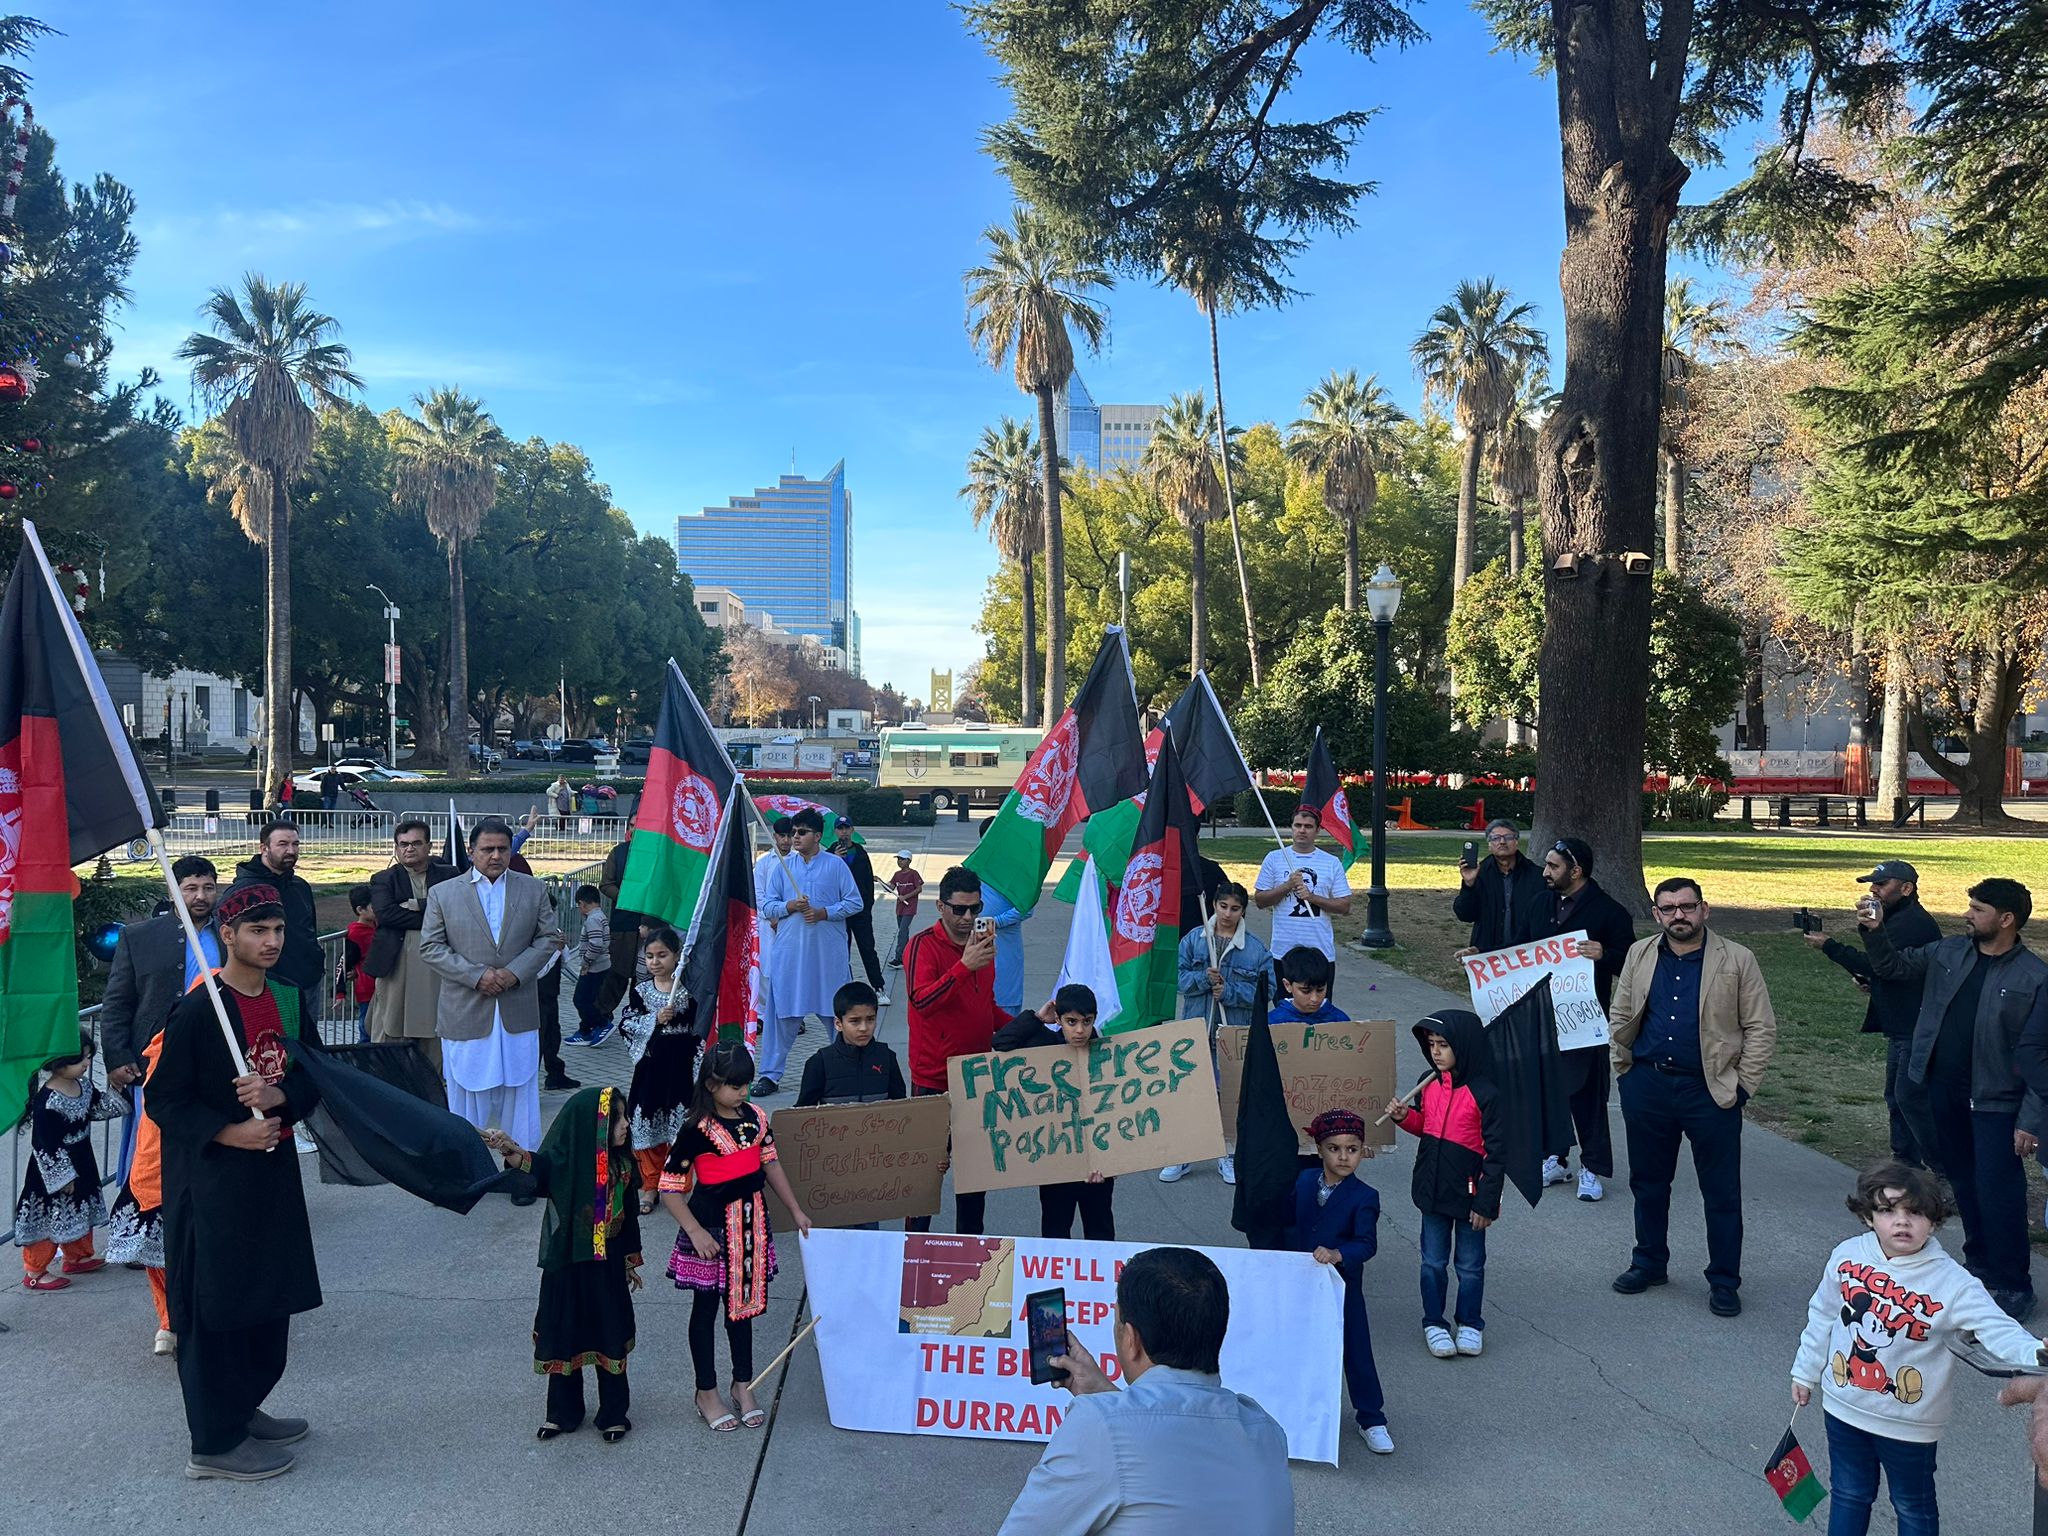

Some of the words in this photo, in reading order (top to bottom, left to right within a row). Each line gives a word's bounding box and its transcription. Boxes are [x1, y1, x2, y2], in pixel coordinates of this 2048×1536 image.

[767, 752, 788, 760] DPR
[805, 752, 825, 761] DPR
[1735, 758, 1753, 766] DPR
[1770, 758, 1790, 766] DPR
[1807, 758, 1827, 766] DPR
[1467, 937, 1582, 990] RELEASE
[1488, 972, 1588, 1015] MAOOR
[961, 1053, 1082, 1100] Free
[1088, 1036, 1198, 1084] Free
[800, 1142, 929, 1182] Pashteen
[807, 1176, 913, 1210] Genocide
[924, 1239, 964, 1247] AFGHANISTAN
[1021, 1255, 1105, 1282] WE'LL
[1838, 1260, 1944, 1318] MICKEY
[920, 1342, 986, 1375] THE
